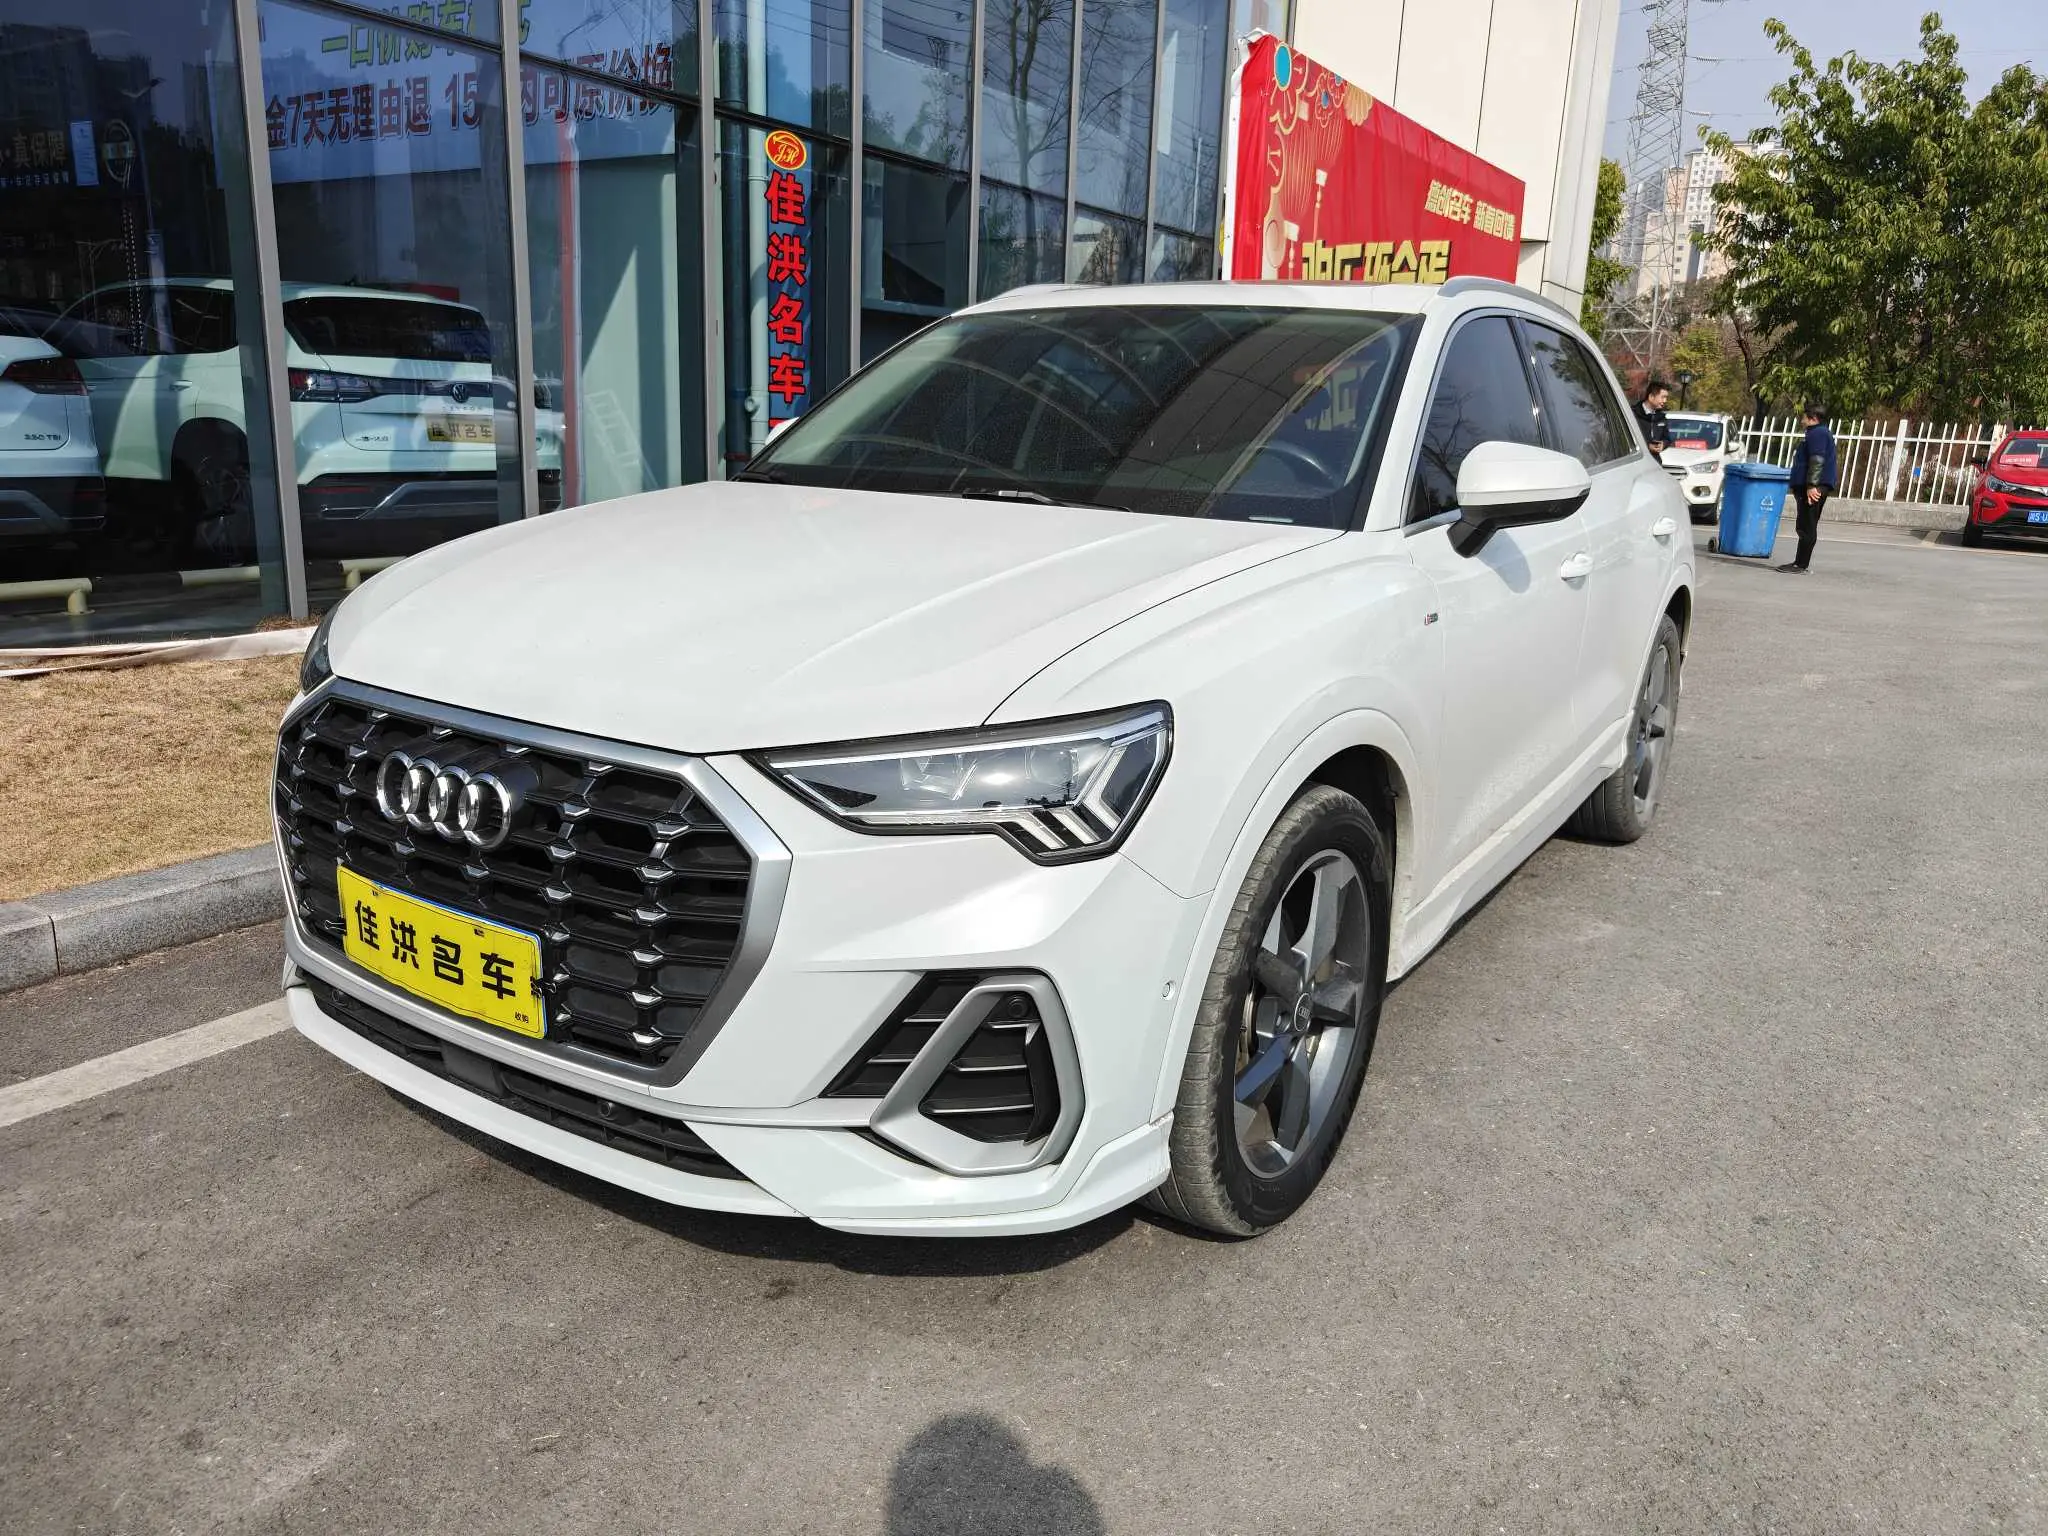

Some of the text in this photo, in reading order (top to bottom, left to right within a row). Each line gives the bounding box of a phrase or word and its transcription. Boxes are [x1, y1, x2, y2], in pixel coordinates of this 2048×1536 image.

[765, 170, 807, 428] 佳洪名车
[354, 900, 516, 1000] 佳洪名车
